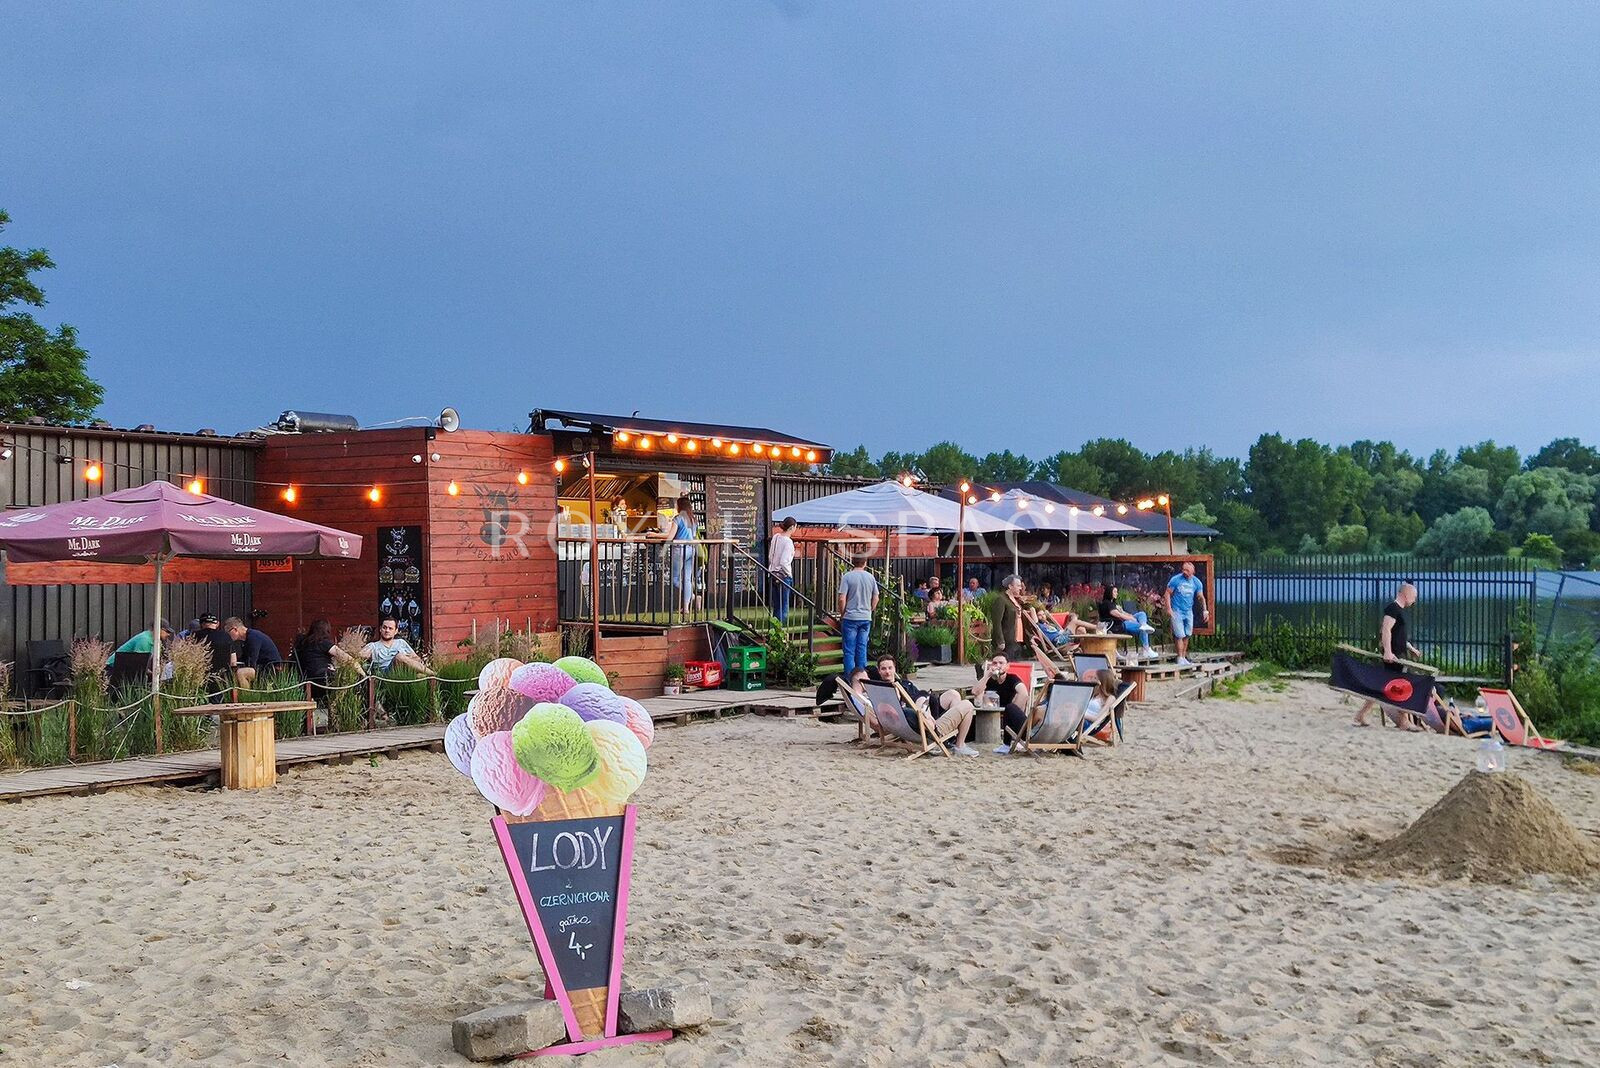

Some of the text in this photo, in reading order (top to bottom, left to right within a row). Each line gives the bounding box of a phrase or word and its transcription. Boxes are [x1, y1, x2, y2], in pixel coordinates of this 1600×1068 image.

[102, 515, 148, 527] DARK
[81, 537, 101, 550] DARK
[243, 533, 262, 546] DARK
[531, 826, 613, 872] LODY
